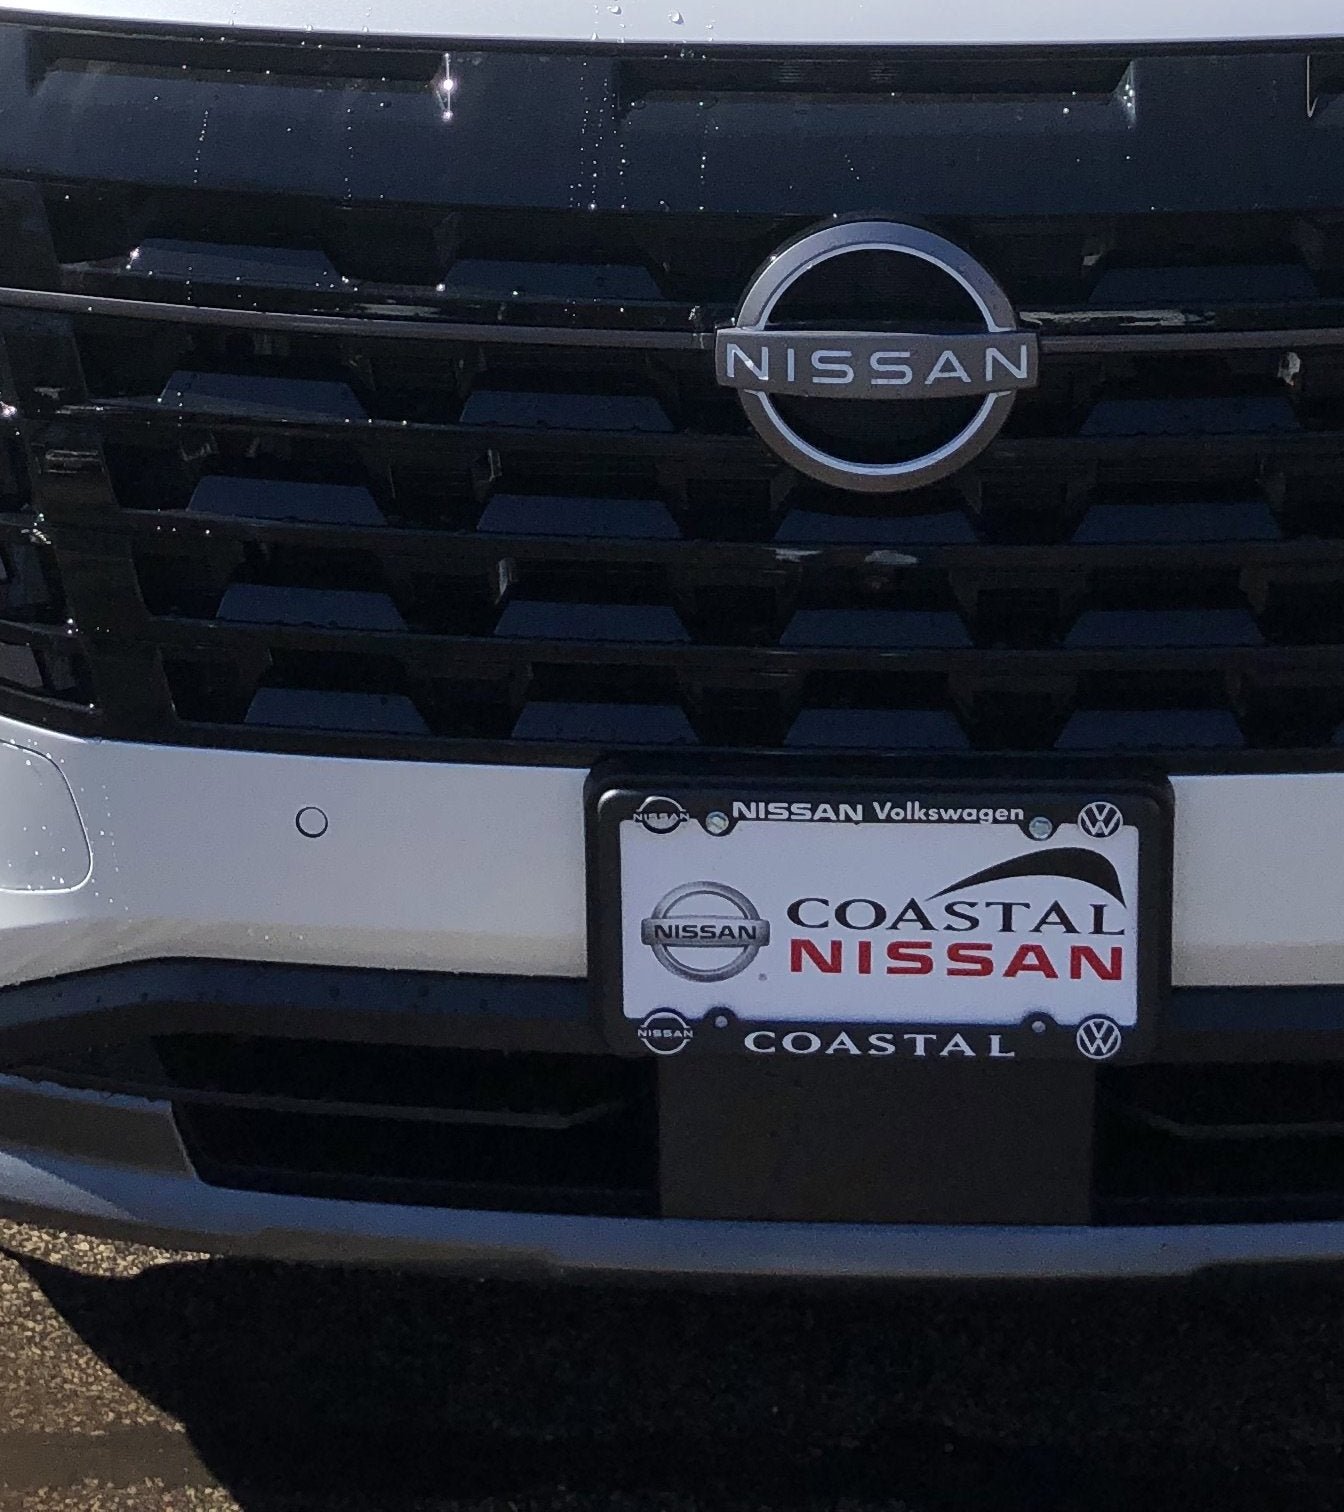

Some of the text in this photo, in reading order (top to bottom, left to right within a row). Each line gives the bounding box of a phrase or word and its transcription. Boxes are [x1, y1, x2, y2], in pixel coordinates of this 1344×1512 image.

[726, 343, 1028, 385] NISSAN
[633, 812, 690, 823] NISSAN
[732, 801, 1024, 824] NISSAN Volkswagen
[787, 897, 1125, 936] COASTAL
[654, 924, 757, 940] NISSAN
[790, 939, 1122, 981] NISSAN
[637, 1029, 693, 1038] NISSAN
[744, 1031, 1015, 1057] COASTAL
